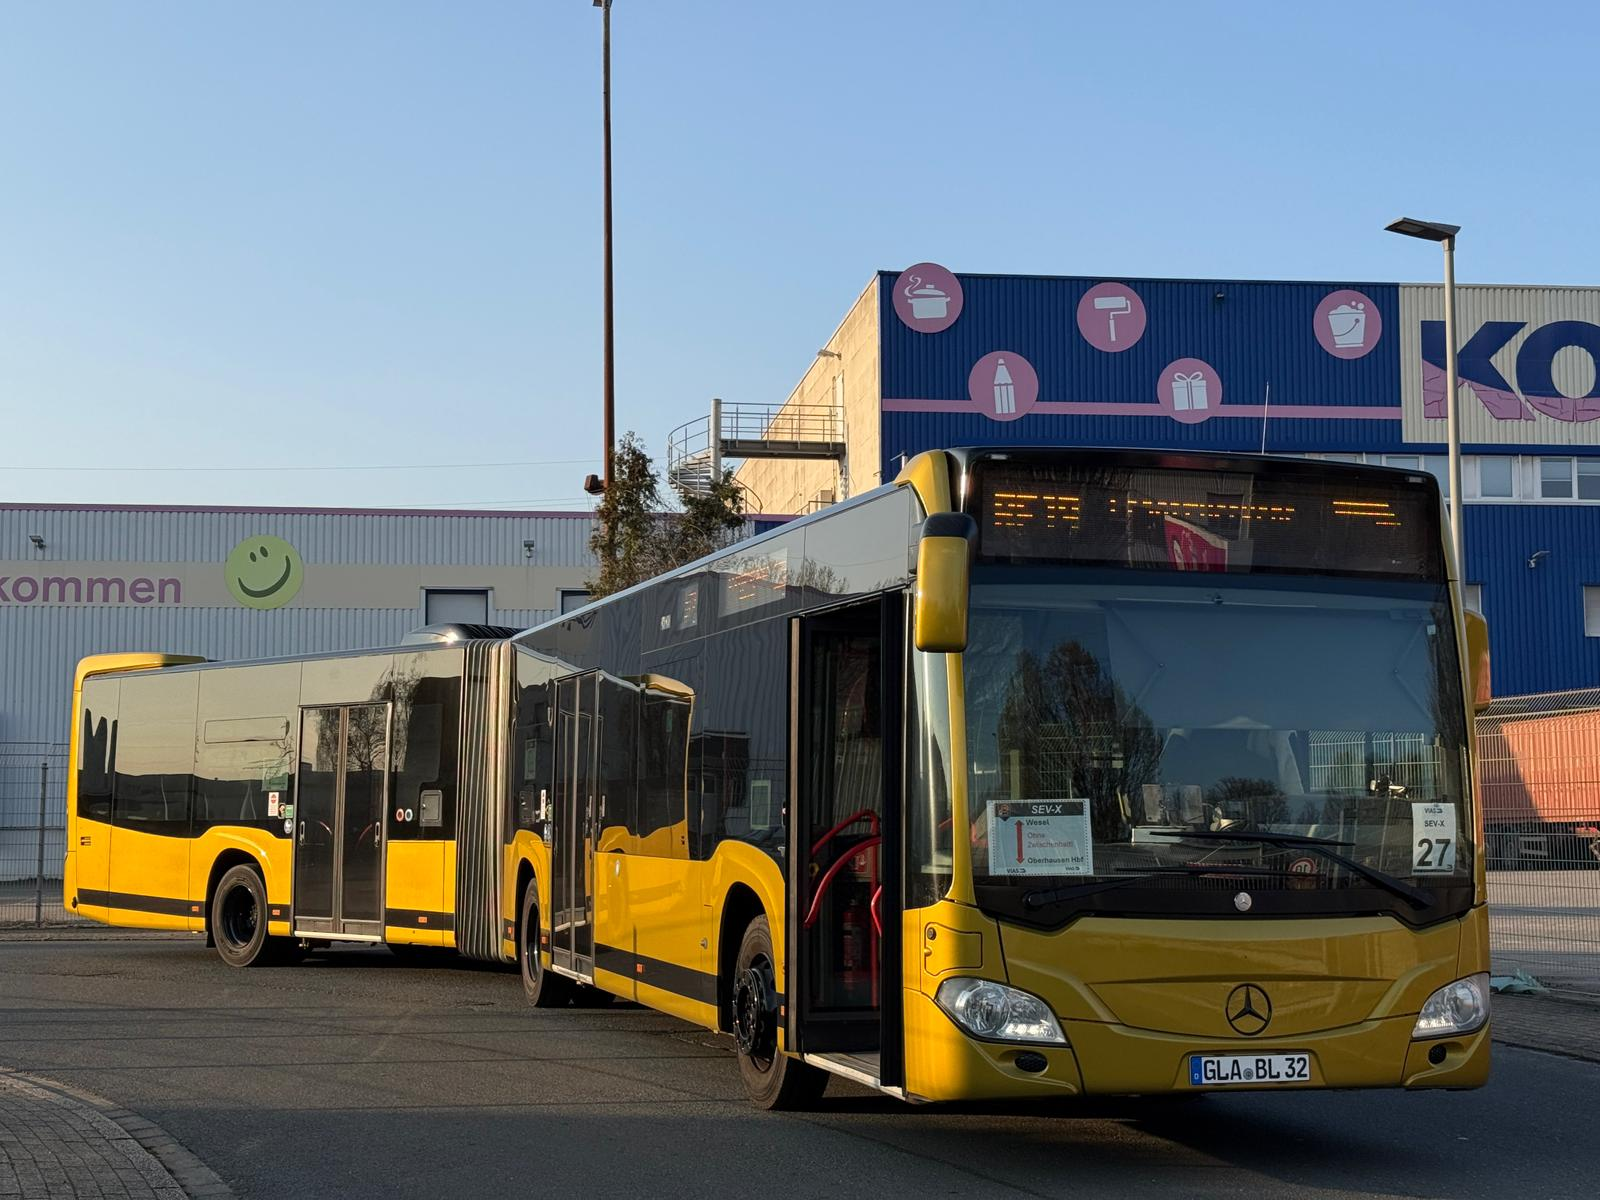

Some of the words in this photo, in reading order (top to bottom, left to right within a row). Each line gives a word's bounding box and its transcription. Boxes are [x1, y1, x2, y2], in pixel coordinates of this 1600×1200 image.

[1421, 320, 1600, 422] KO
[1031, 804, 1063, 814] SEV-X
[1416, 838, 1451, 866] 27
[1203, 1059, 1242, 1080] GLA
[1255, 1058, 1280, 1079] BL
[1284, 1057, 1308, 1078] 32
